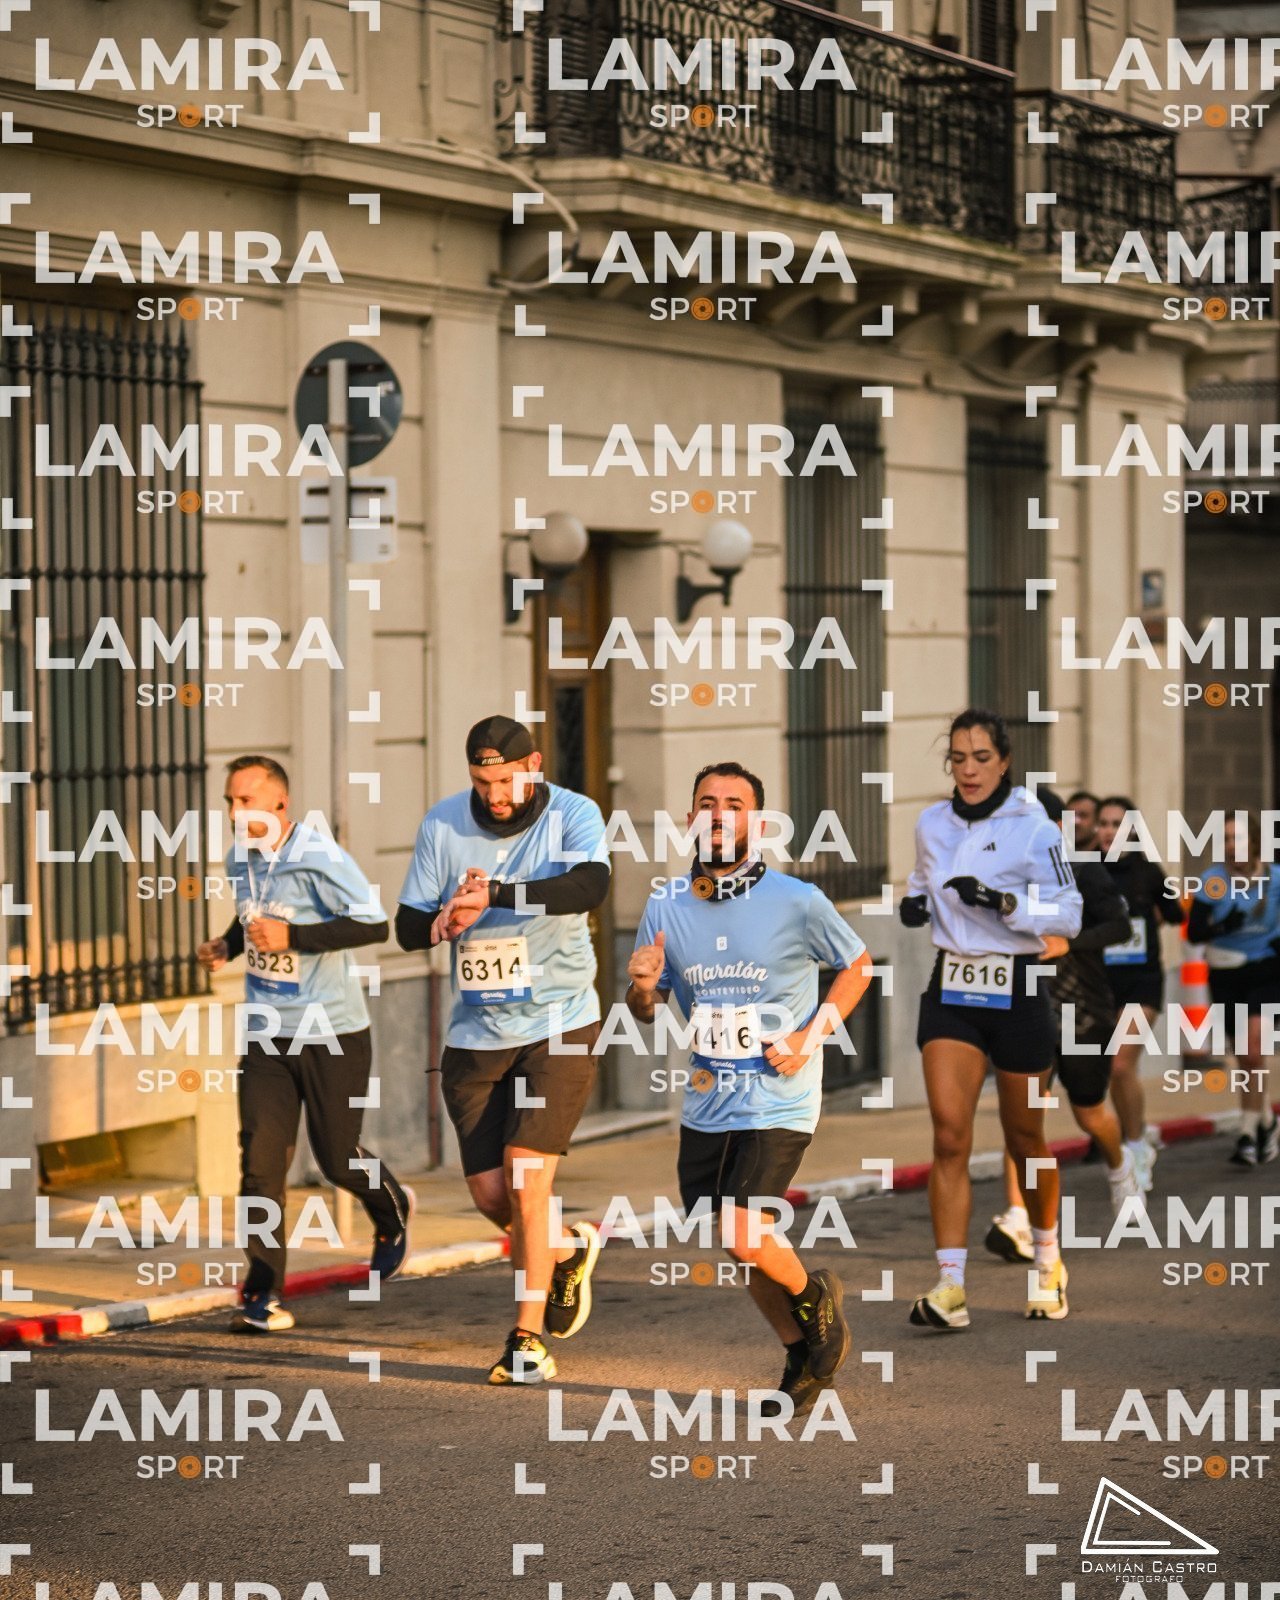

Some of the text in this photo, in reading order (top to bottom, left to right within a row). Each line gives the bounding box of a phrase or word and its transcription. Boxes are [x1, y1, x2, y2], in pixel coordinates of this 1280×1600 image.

[247, 949, 294, 974] 6523
[461, 957, 524, 982] 6314
[684, 960, 769, 987] Maratón
[948, 961, 1008, 987] 7616
[695, 984, 761, 997] MONTEVIDEO
